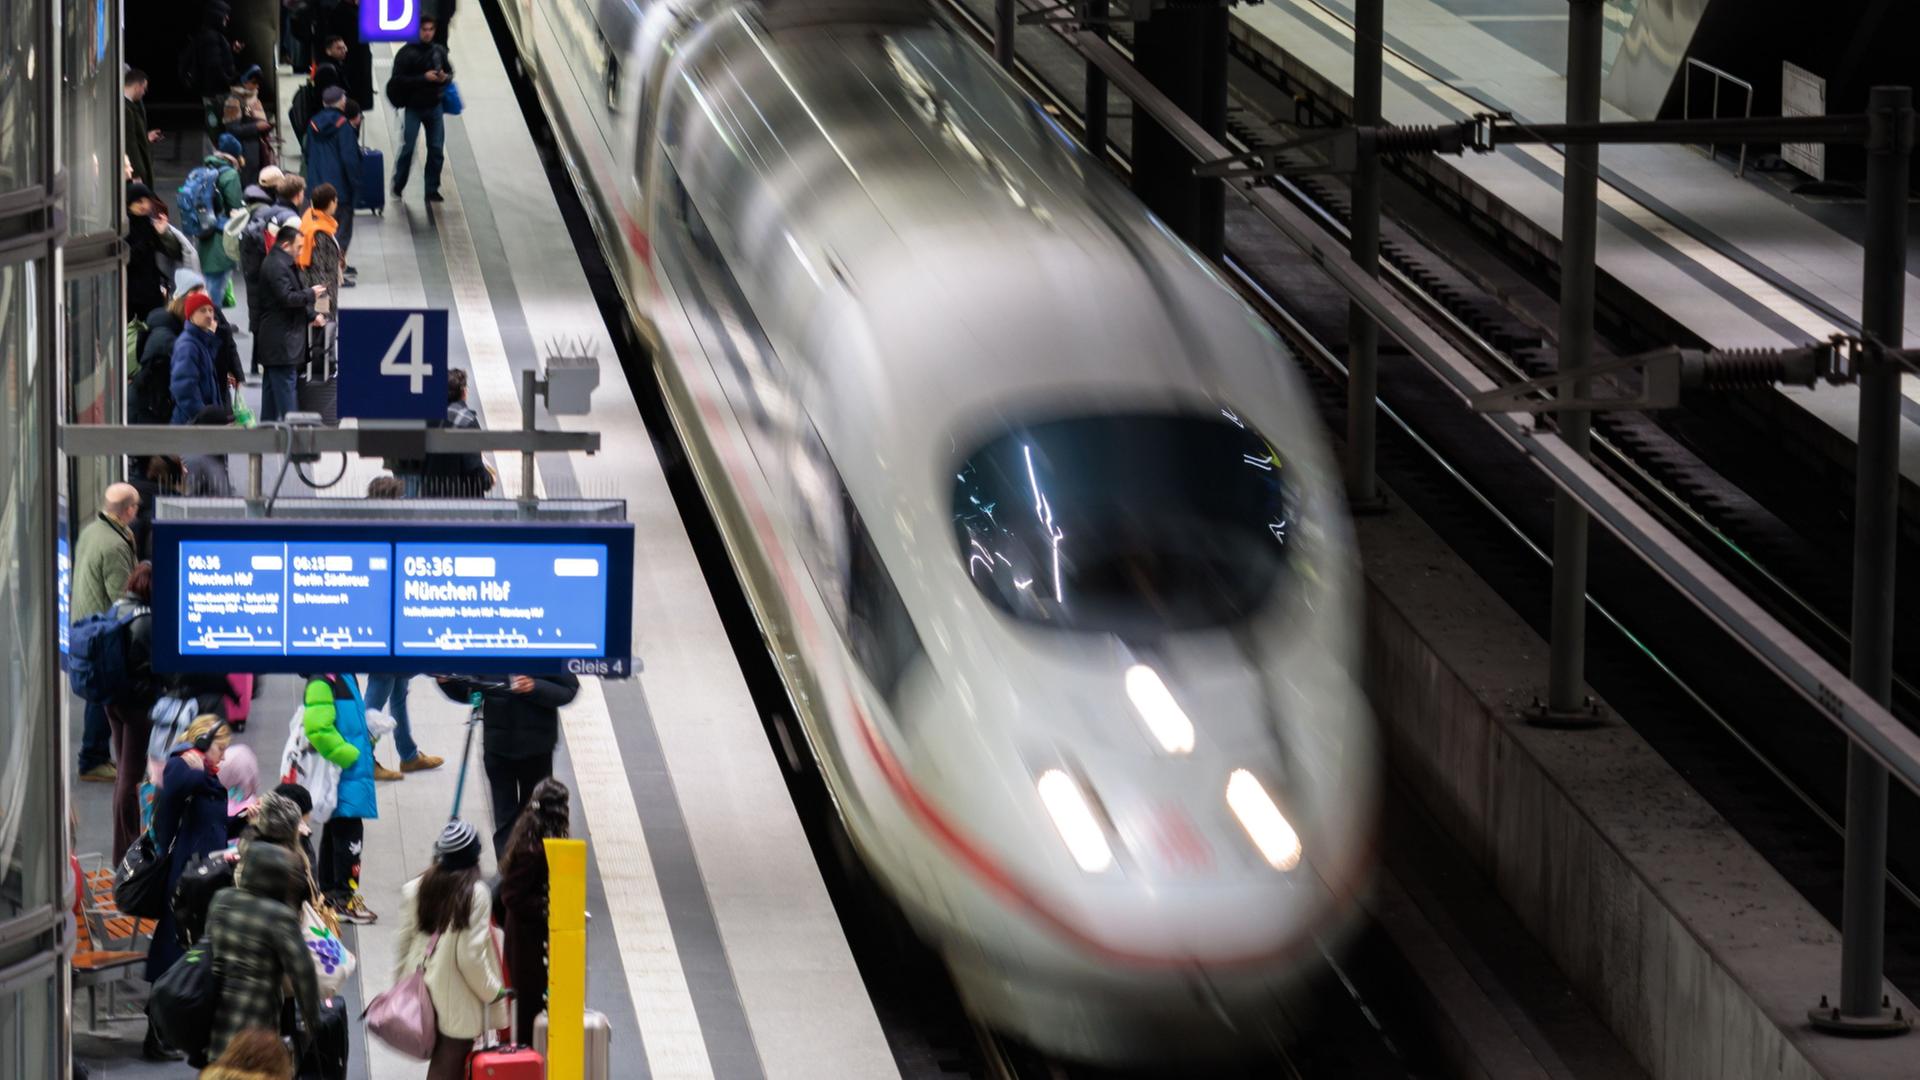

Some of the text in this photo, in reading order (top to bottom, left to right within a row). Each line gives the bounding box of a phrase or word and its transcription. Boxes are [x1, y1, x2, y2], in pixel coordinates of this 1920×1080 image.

[379, 0, 413, 30] D
[380, 313, 433, 394] 4
[404, 557, 453, 577] 05:36
[188, 571, 233, 586] München
[404, 580, 511, 601] München Hbf
[567, 658, 623, 674] Gleis 4
